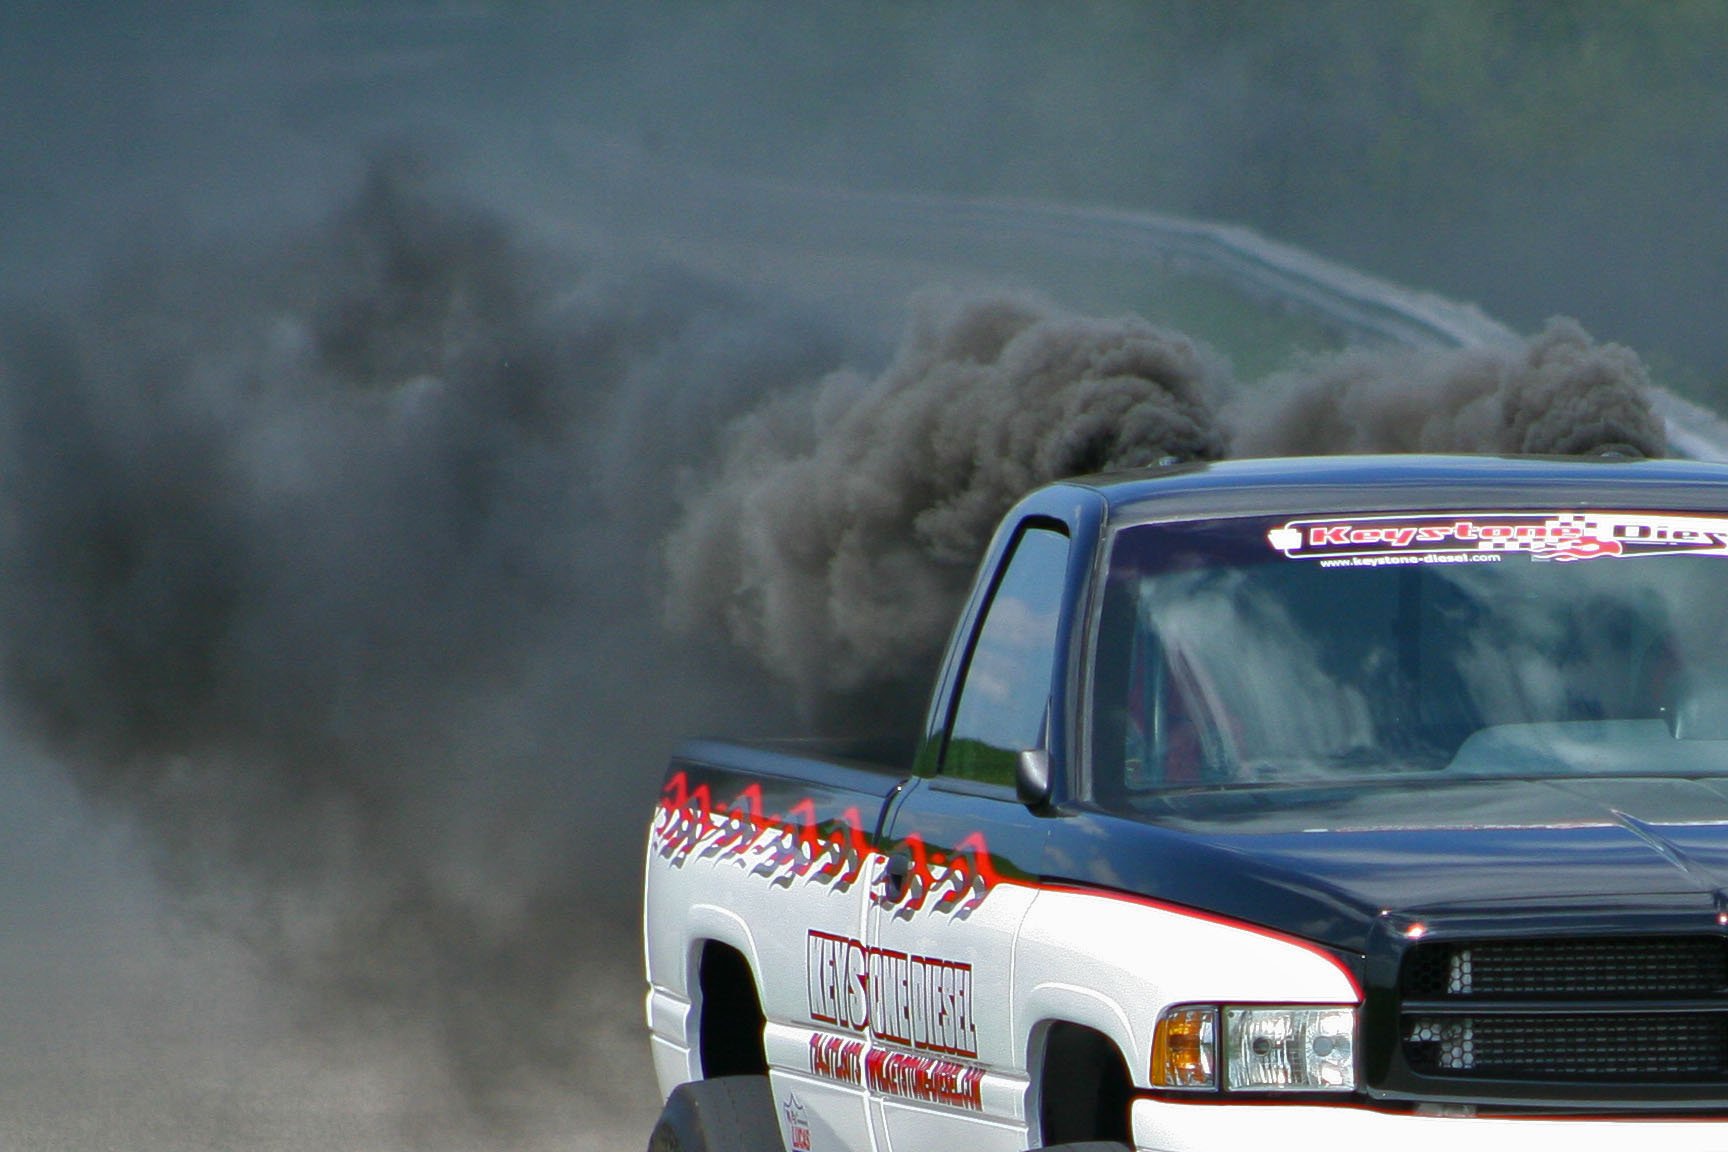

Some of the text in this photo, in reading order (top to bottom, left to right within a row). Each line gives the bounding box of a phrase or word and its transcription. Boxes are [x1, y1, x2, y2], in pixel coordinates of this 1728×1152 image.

[1308, 520, 1584, 549] Keystone
[1320, 551, 1502, 569] www.keystone-diesel.com
[807, 928, 912, 1046] KEYSONE
[910, 954, 979, 1059] DIESEL
